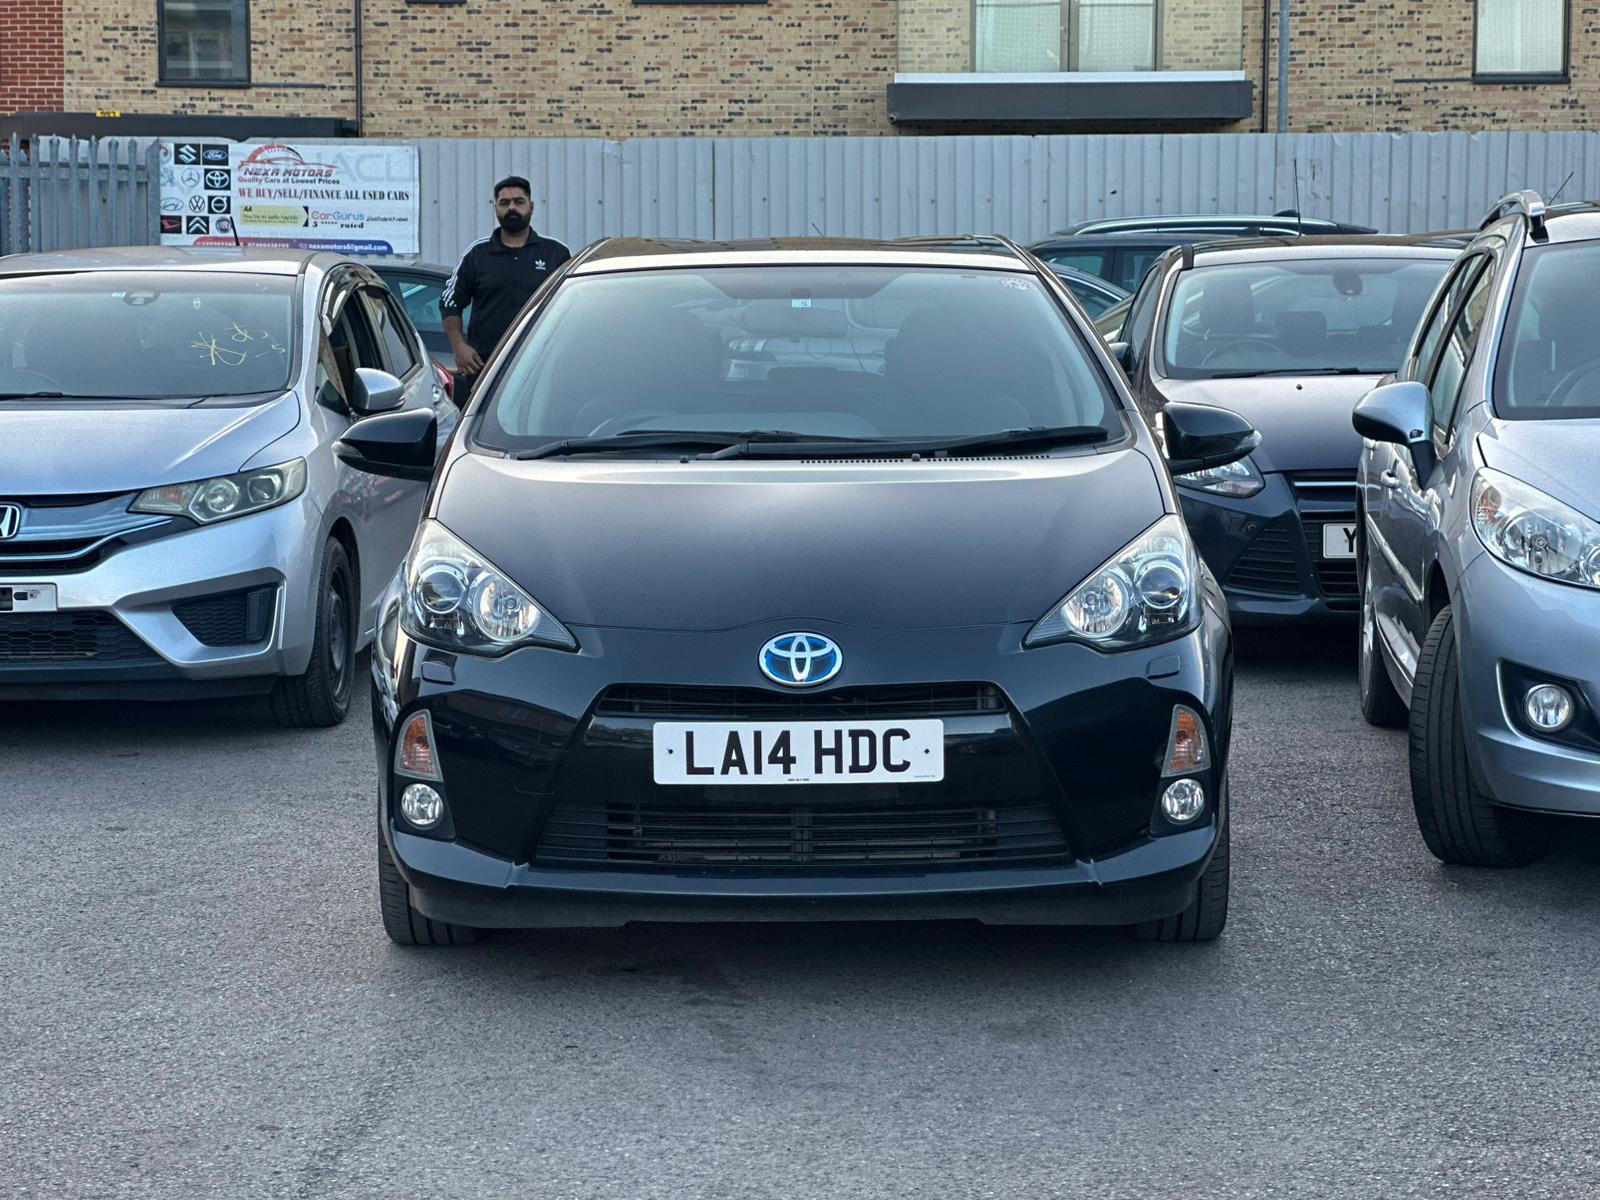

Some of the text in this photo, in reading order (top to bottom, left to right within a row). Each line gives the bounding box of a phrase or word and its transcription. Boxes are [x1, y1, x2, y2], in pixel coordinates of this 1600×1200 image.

[243, 167, 333, 177] NEXA MOTORS
[238, 176, 263, 184] Quality
[239, 187, 253, 198] WE
[344, 189, 360, 200] ALL
[362, 190, 385, 200] USED
[387, 190, 410, 200] CARS
[311, 210, 365, 221] CarGurus
[685, 728, 911, 775] LA14 HDC
